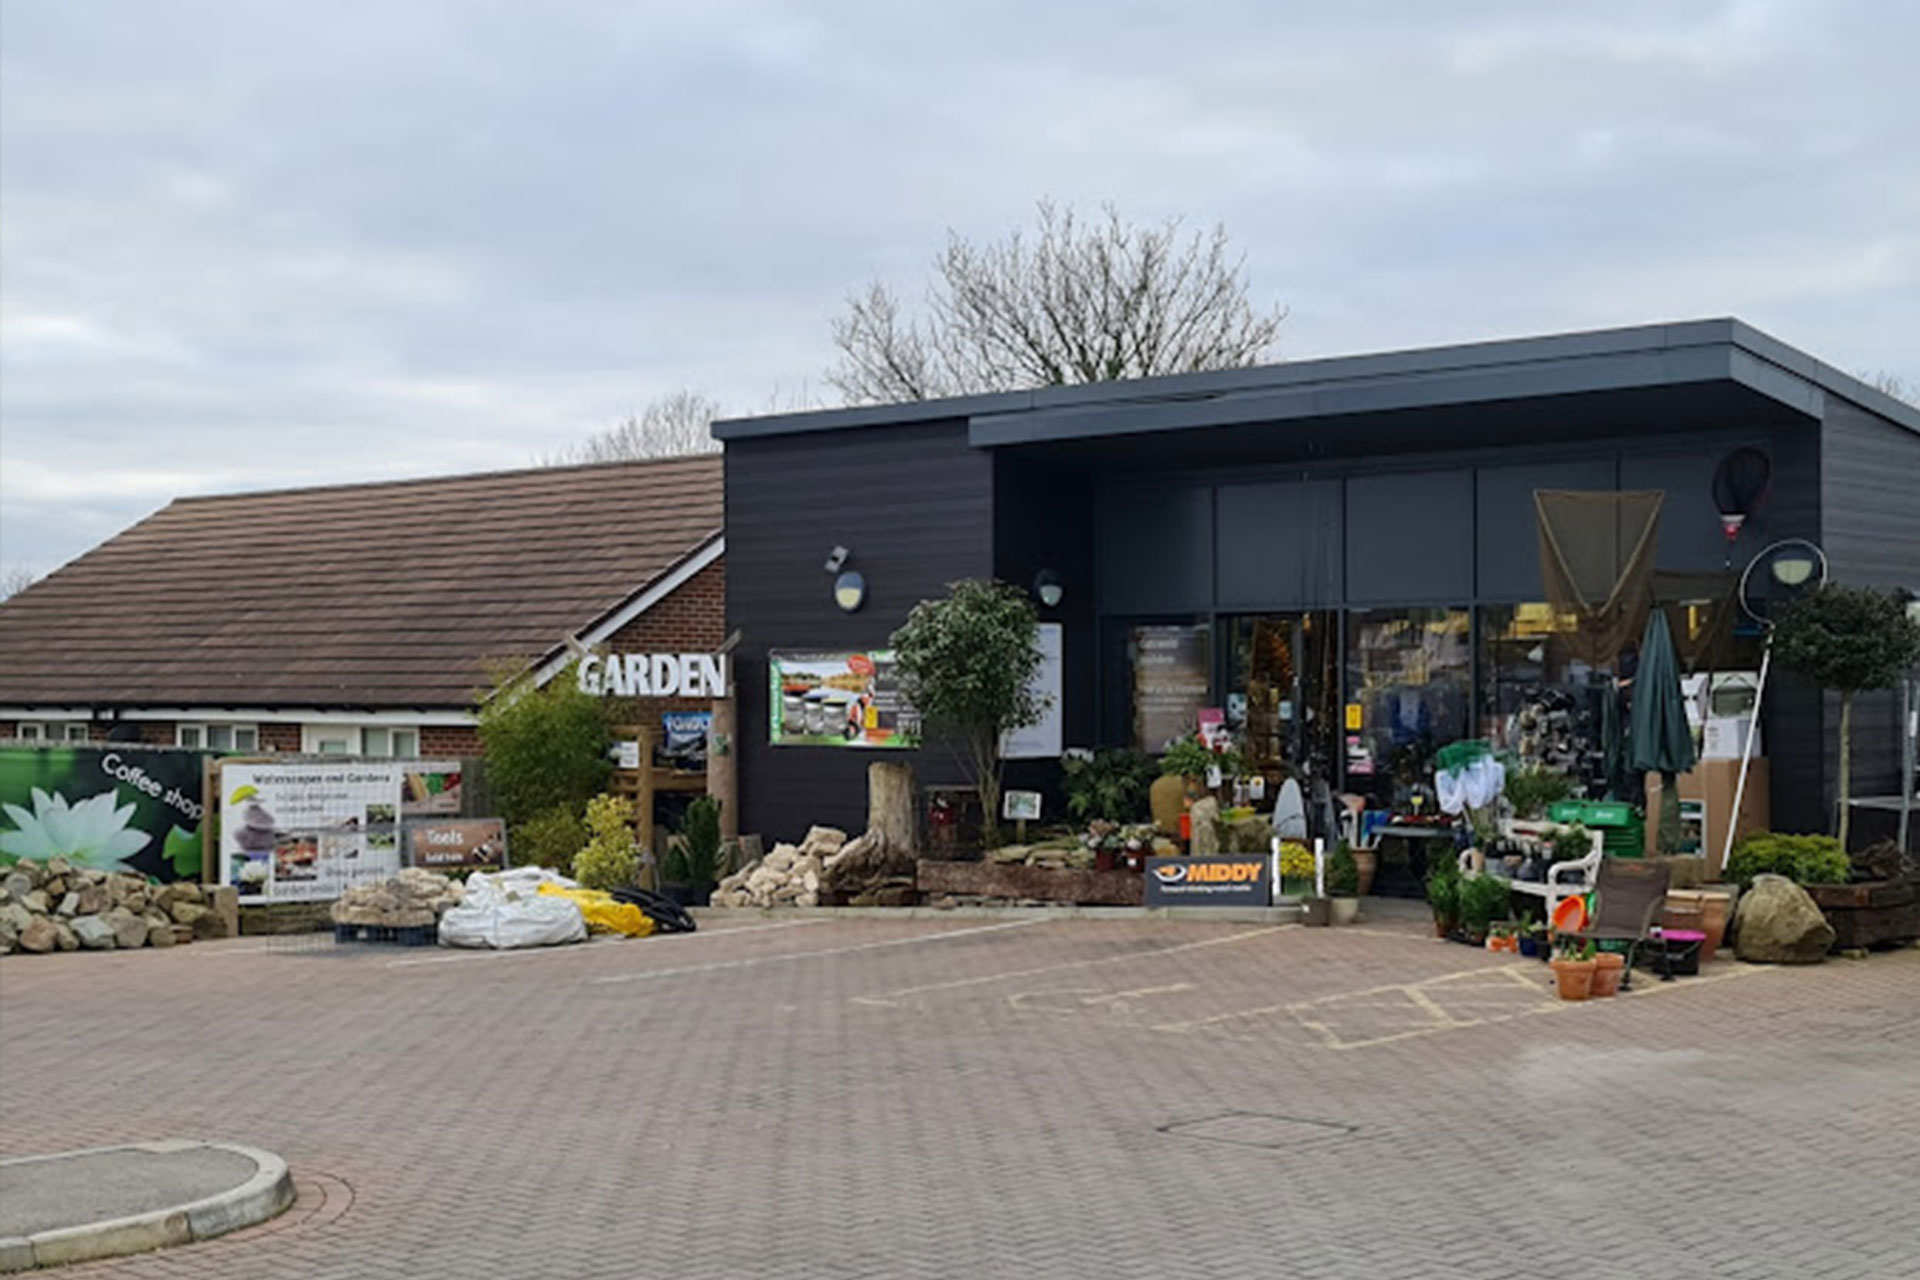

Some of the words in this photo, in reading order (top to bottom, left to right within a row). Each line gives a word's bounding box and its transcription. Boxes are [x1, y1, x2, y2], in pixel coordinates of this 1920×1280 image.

[577, 653, 726, 697] GARDEN
[102, 753, 162, 797] Coffee
[163, 787, 205, 819] shop
[1186, 862, 1262, 883] MIDDY
